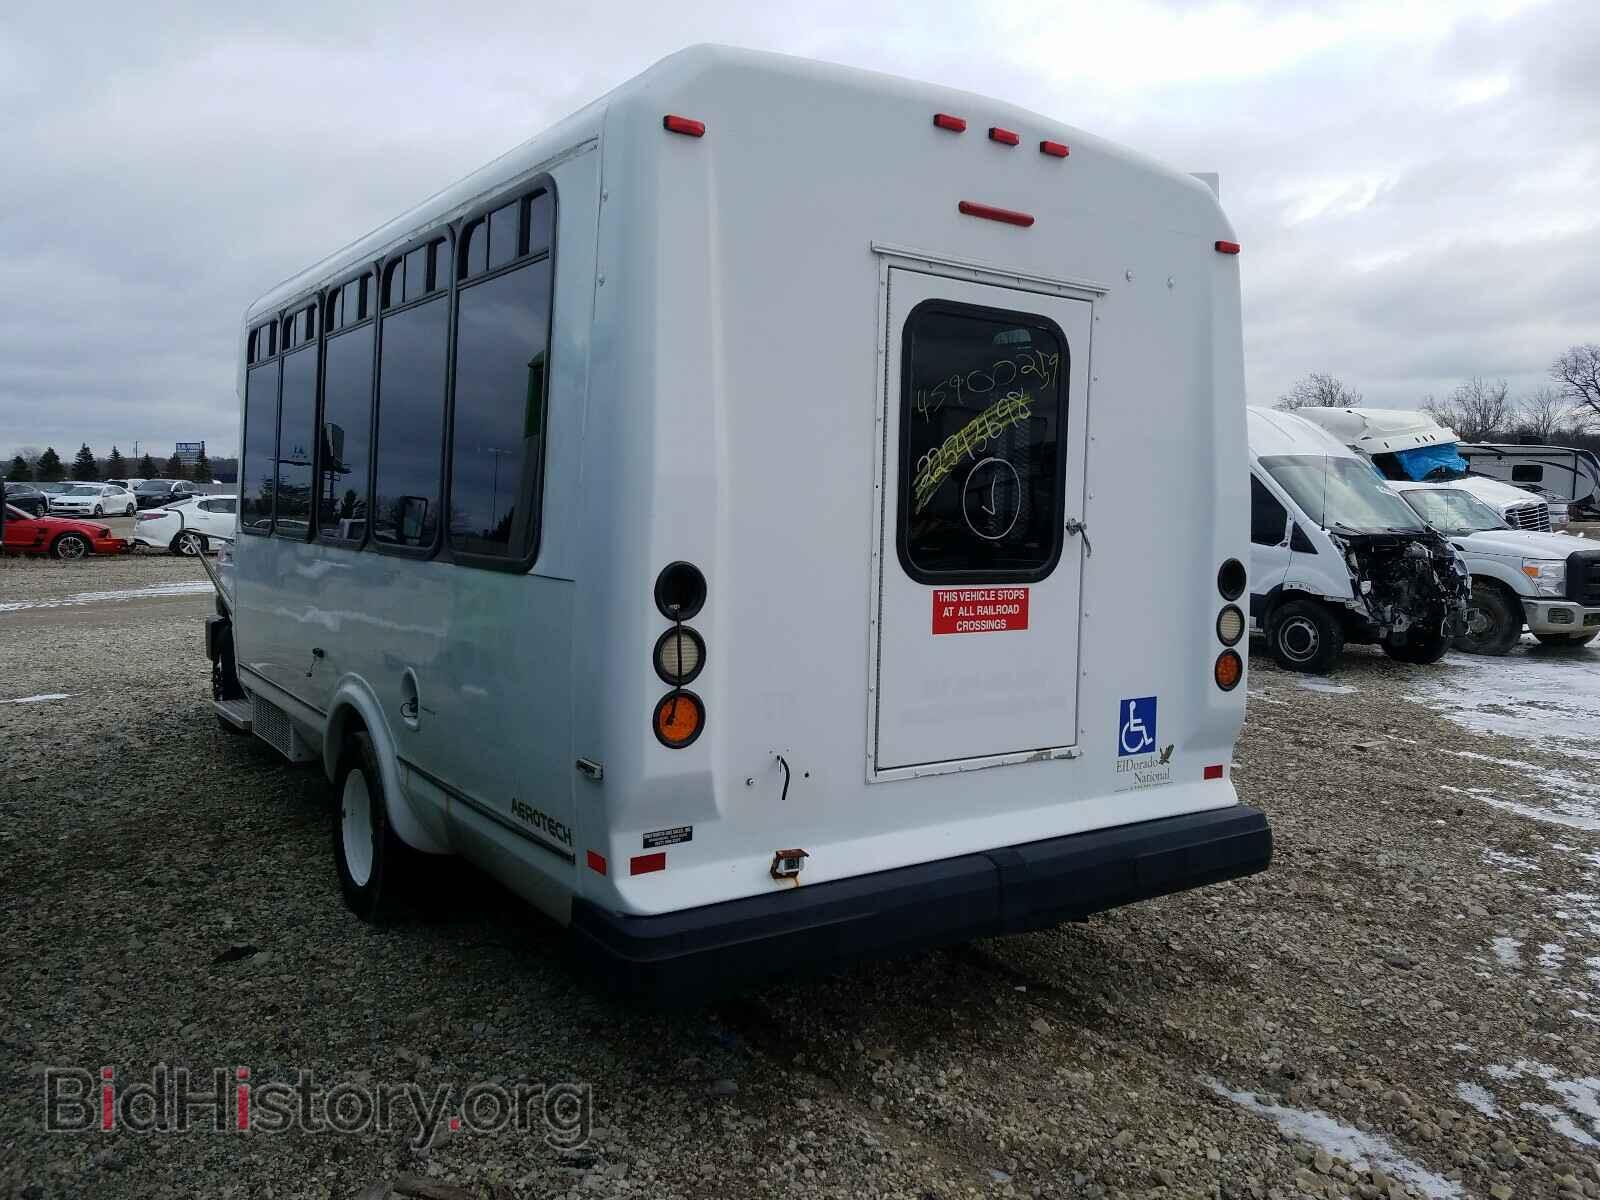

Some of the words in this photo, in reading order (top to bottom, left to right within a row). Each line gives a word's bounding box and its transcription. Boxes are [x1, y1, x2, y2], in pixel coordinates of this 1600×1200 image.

[938, 591, 958, 602] THIS
[960, 590, 996, 602] VEHICLE
[997, 590, 1025, 601] STOPS
[942, 606, 955, 617] AT
[958, 606, 975, 617] ALL
[976, 604, 1020, 616] RAILROAD
[956, 619, 1007, 632] CROSSINGS
[1116, 755, 1159, 773] ElDorado
[1134, 767, 1170, 785] National
[511, 797, 573, 847] AEROTECH
